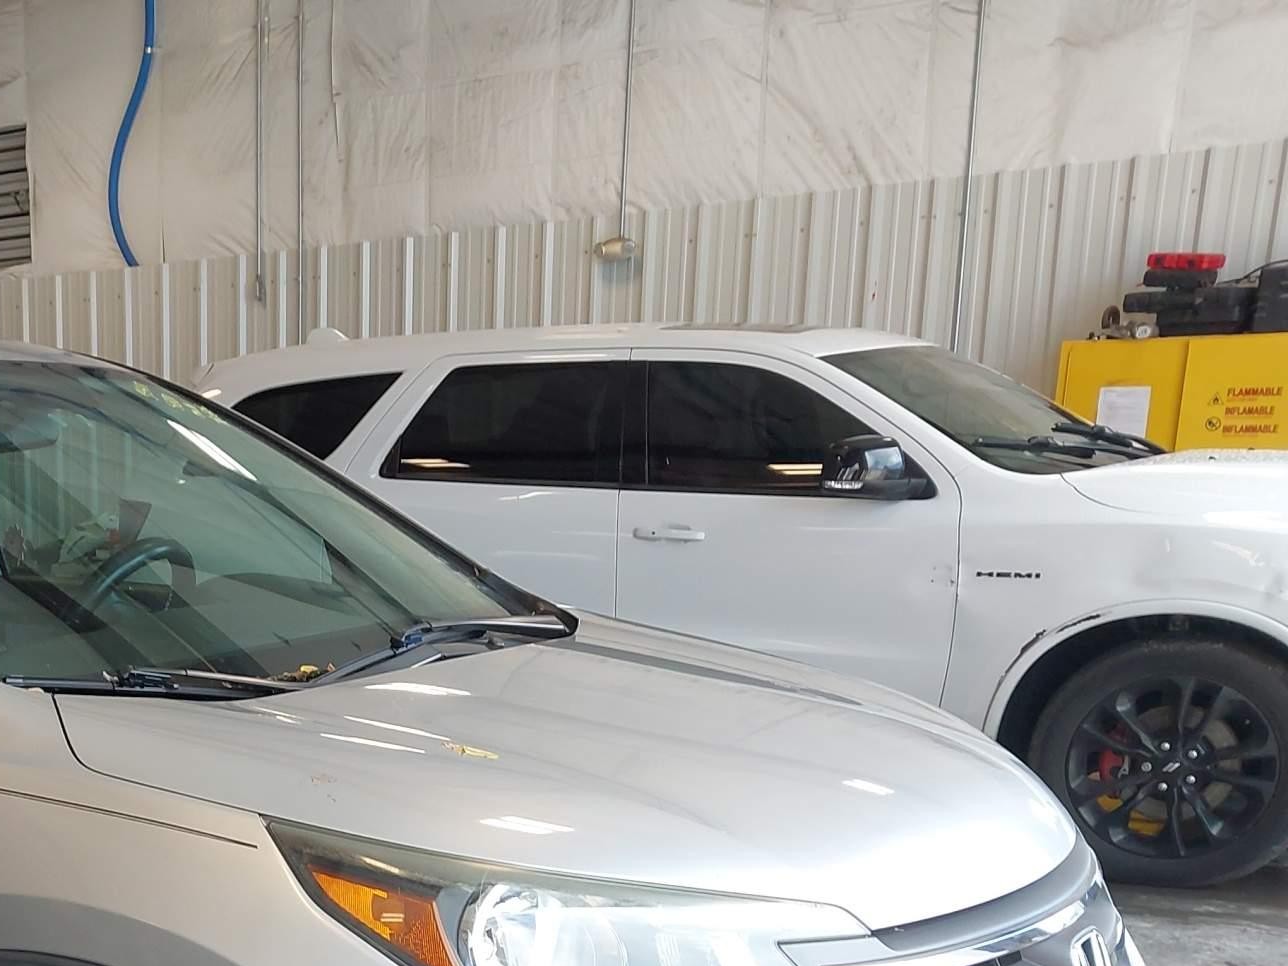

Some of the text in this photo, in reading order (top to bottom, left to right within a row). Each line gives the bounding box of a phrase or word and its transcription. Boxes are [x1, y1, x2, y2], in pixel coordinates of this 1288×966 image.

[1226, 386, 1283, 397] FLAMMABLE
[1224, 405, 1275, 416] INFLAMABLE
[1222, 423, 1279, 434] INFLAMMABLE
[975, 571, 1041, 579] HEMI
